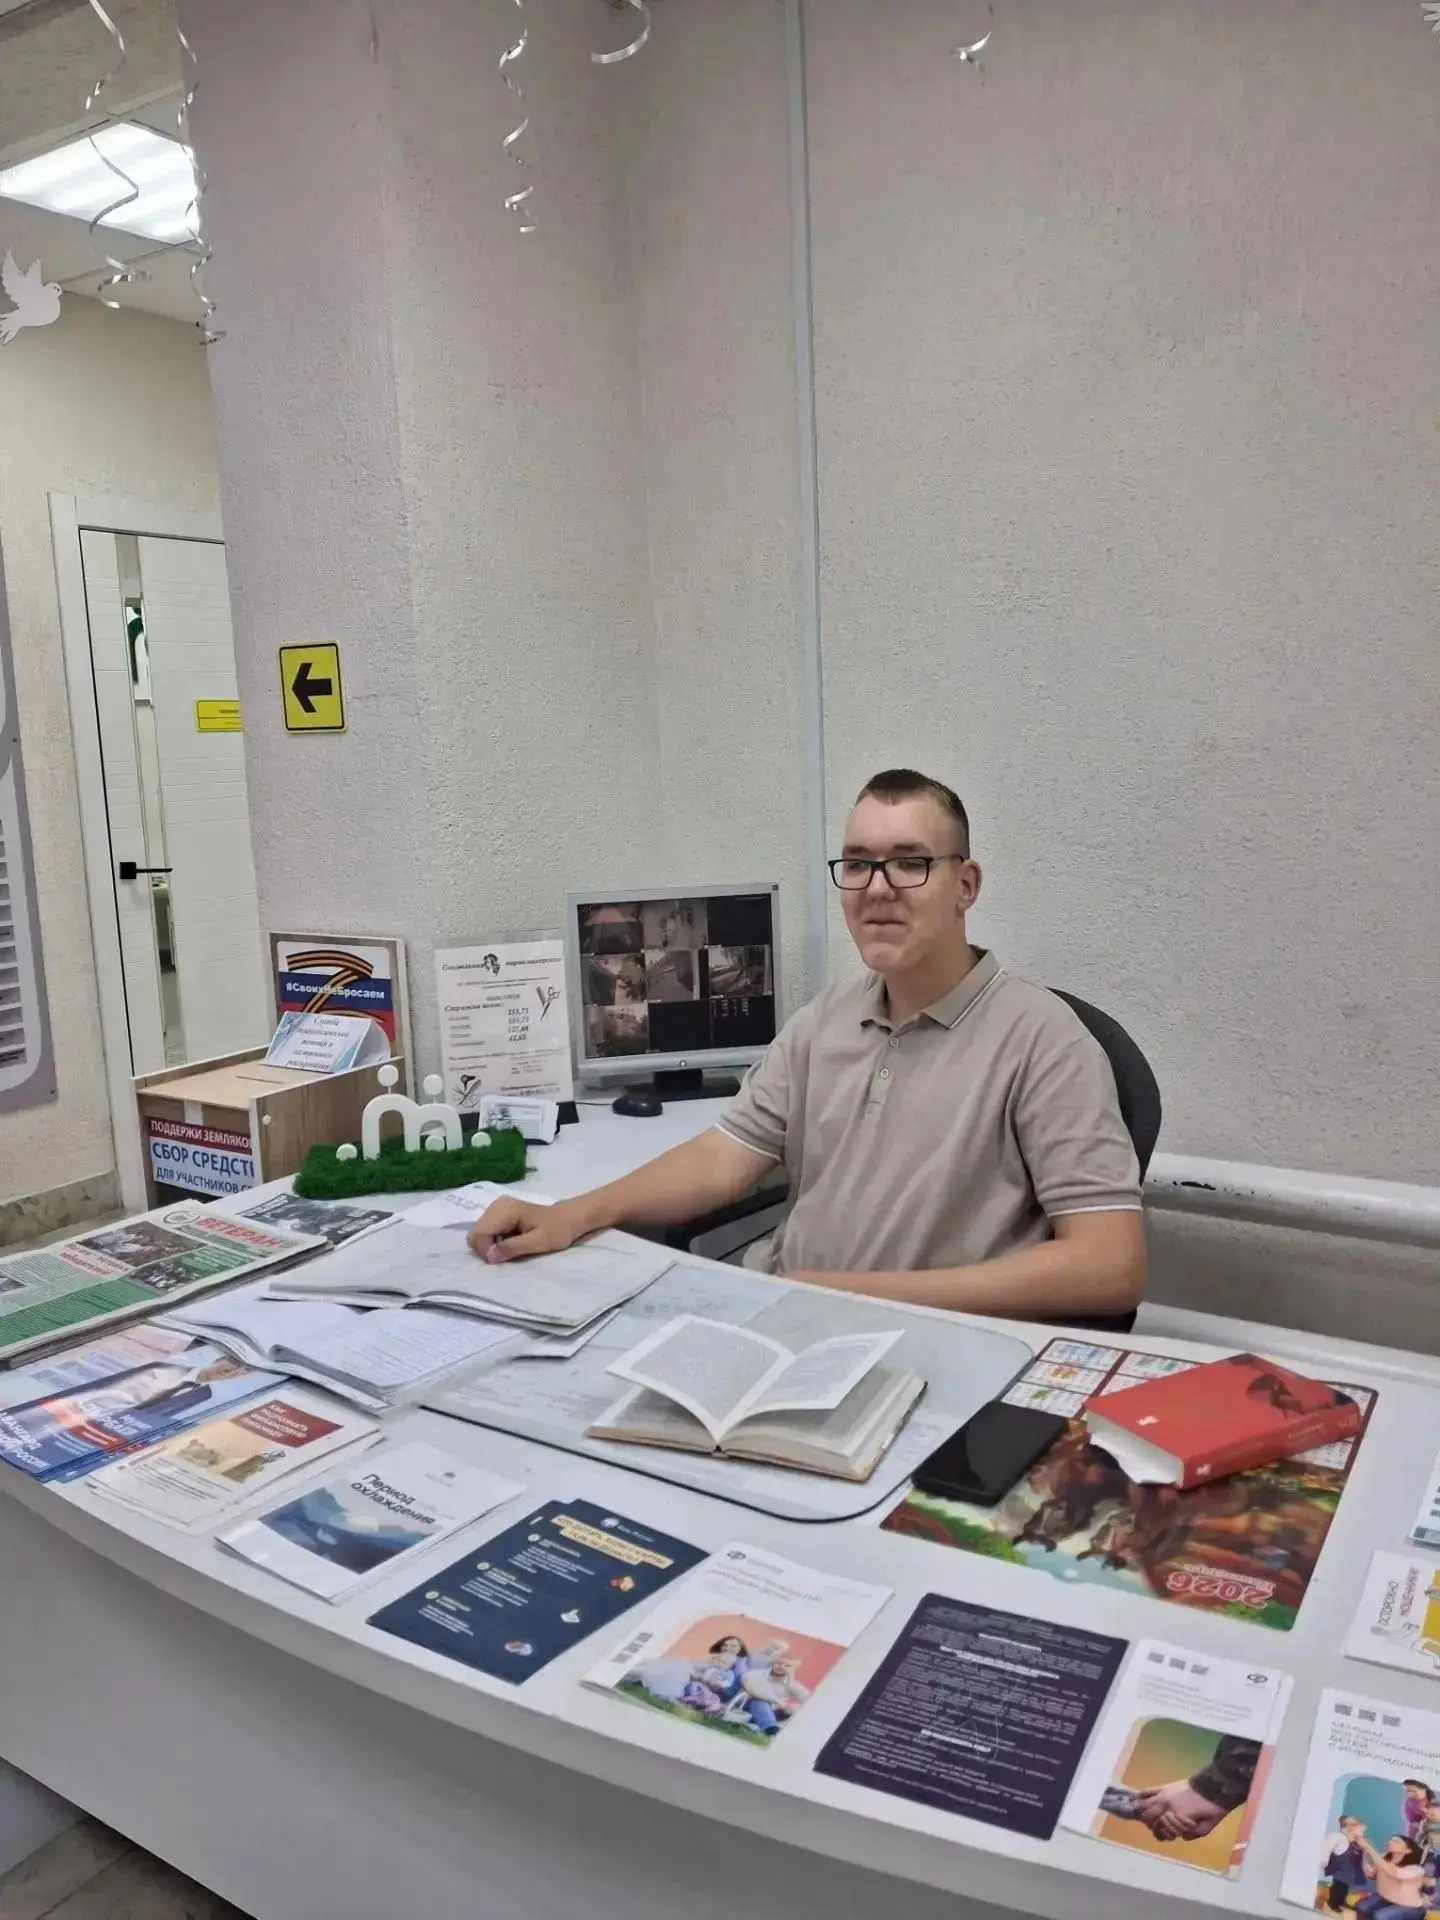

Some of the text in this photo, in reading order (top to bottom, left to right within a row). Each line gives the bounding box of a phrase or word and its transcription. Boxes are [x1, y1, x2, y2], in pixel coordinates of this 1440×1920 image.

[286, 981, 385, 999] #СвоихНеБросаем
[151, 1120, 251, 1148] ПОДДЕРЖИ ЗЕМЛЯКО
[152, 1141, 189, 1164] СБОР
[156, 1166, 240, 1194] ДЛЯ УЧАСТНИКОВ
[197, 1218, 281, 1247] ВЕТЕРАН
[350, 1481, 436, 1525] охлаждения
[362, 1473, 417, 1505] Период
[1166, 1571, 1273, 1609] 2026
